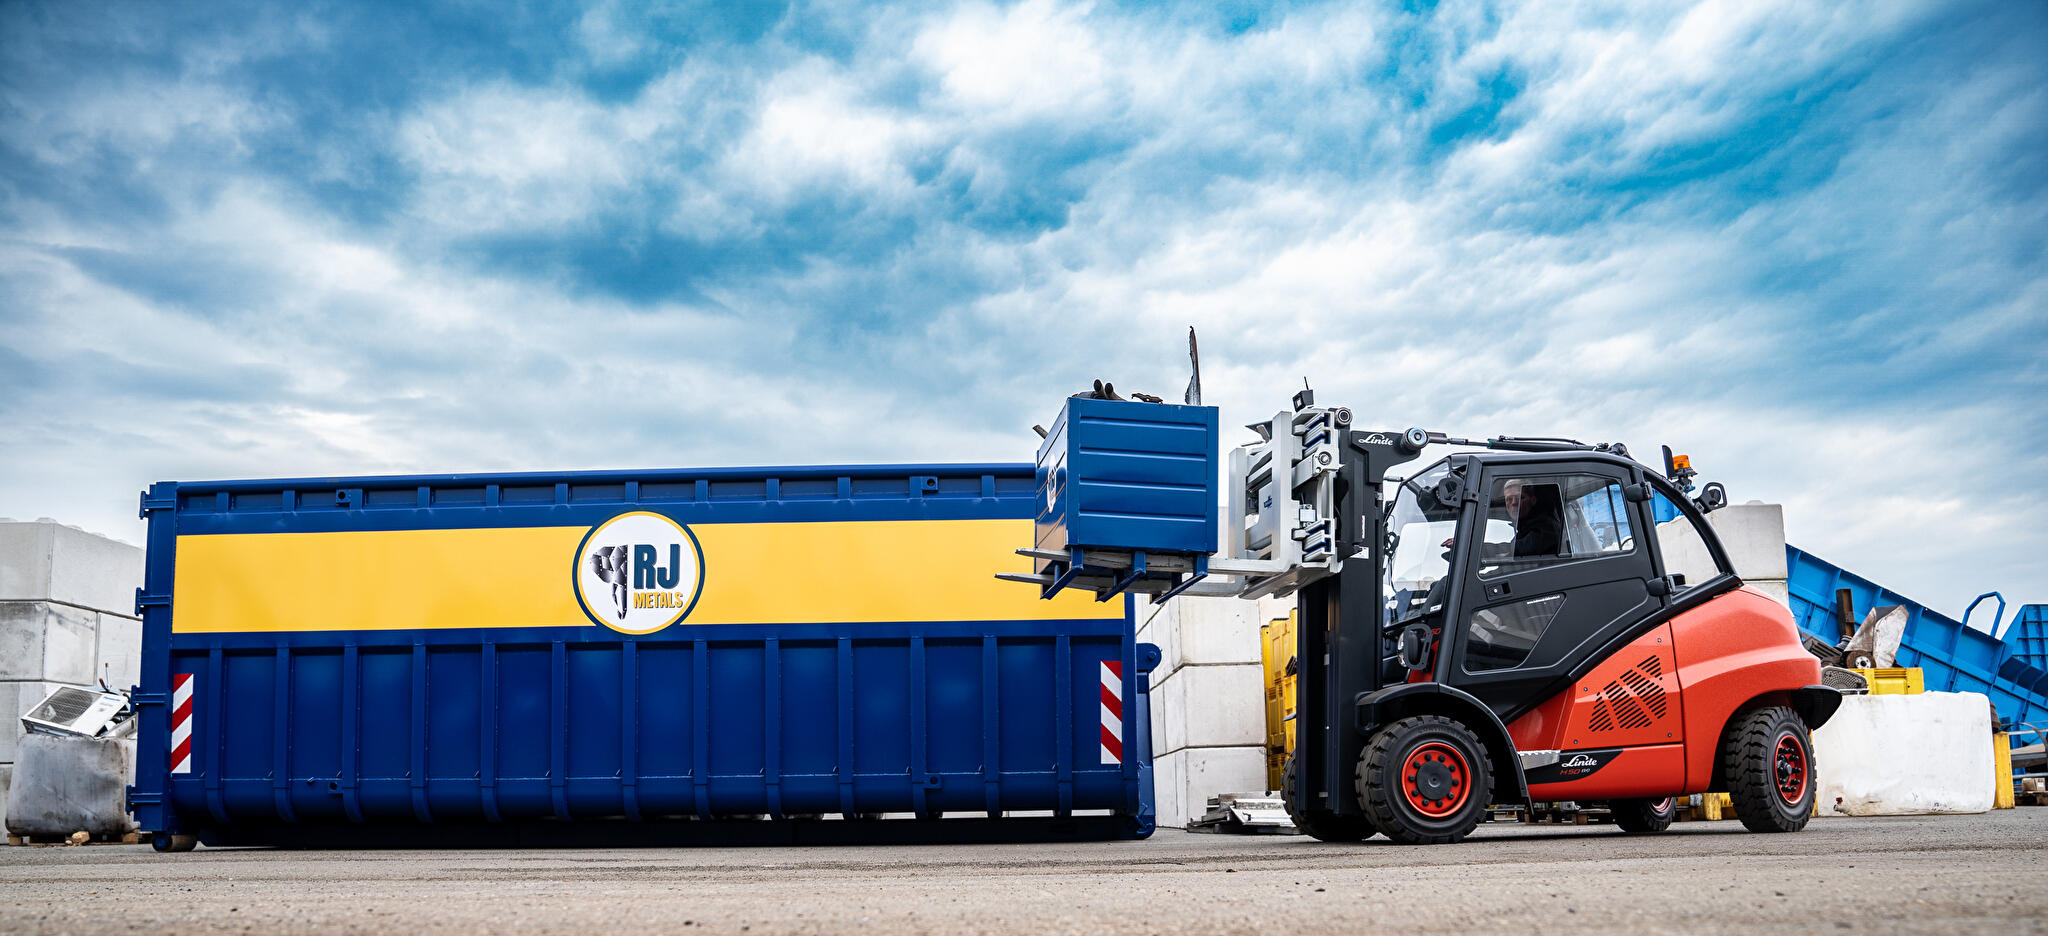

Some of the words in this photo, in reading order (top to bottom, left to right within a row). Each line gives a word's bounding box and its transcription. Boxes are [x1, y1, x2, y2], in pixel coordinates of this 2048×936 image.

[1358, 433, 1393, 445] Linde
[633, 543, 680, 589] RJ
[633, 592, 683, 608] METALS
[1561, 754, 1597, 767] Linde
